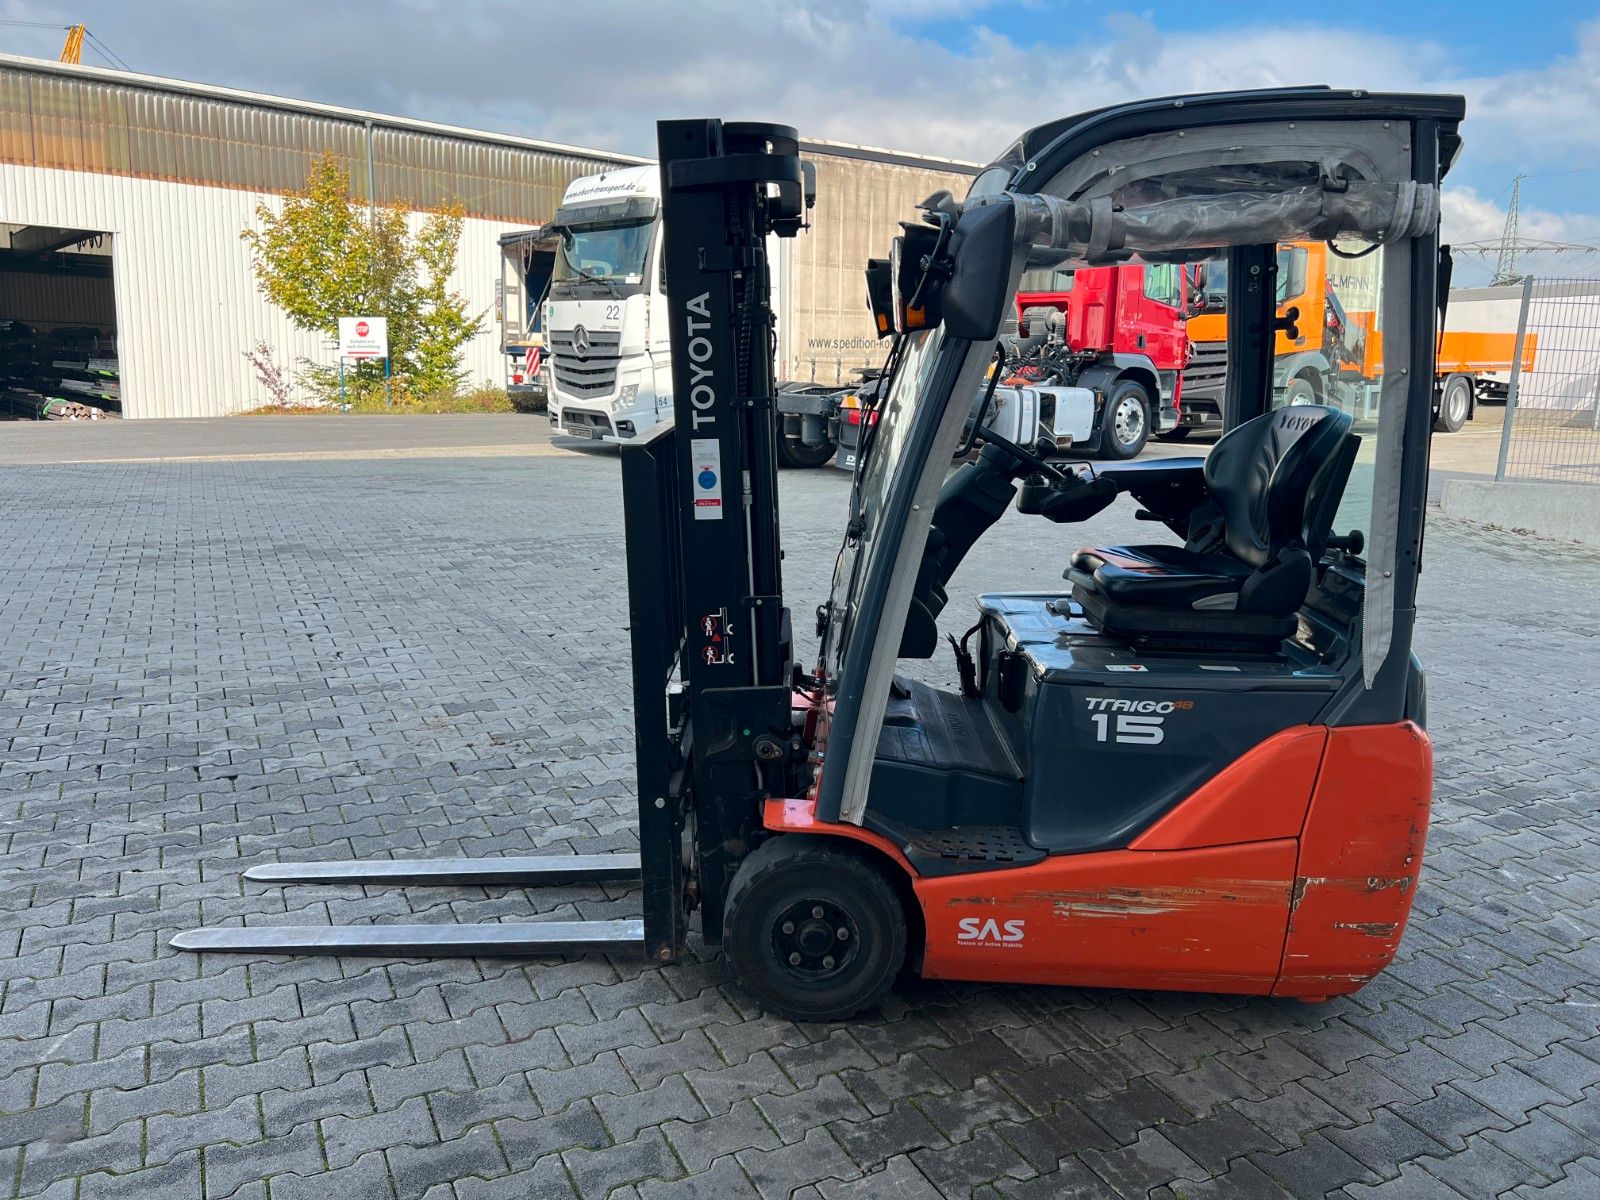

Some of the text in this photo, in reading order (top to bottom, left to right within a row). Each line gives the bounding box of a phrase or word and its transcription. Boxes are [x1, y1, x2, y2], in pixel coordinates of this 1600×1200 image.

[606, 305, 620, 320] 22
[686, 291, 716, 430] TOYOTA
[1091, 713, 1165, 745] 15
[957, 917, 1025, 942] SAS
